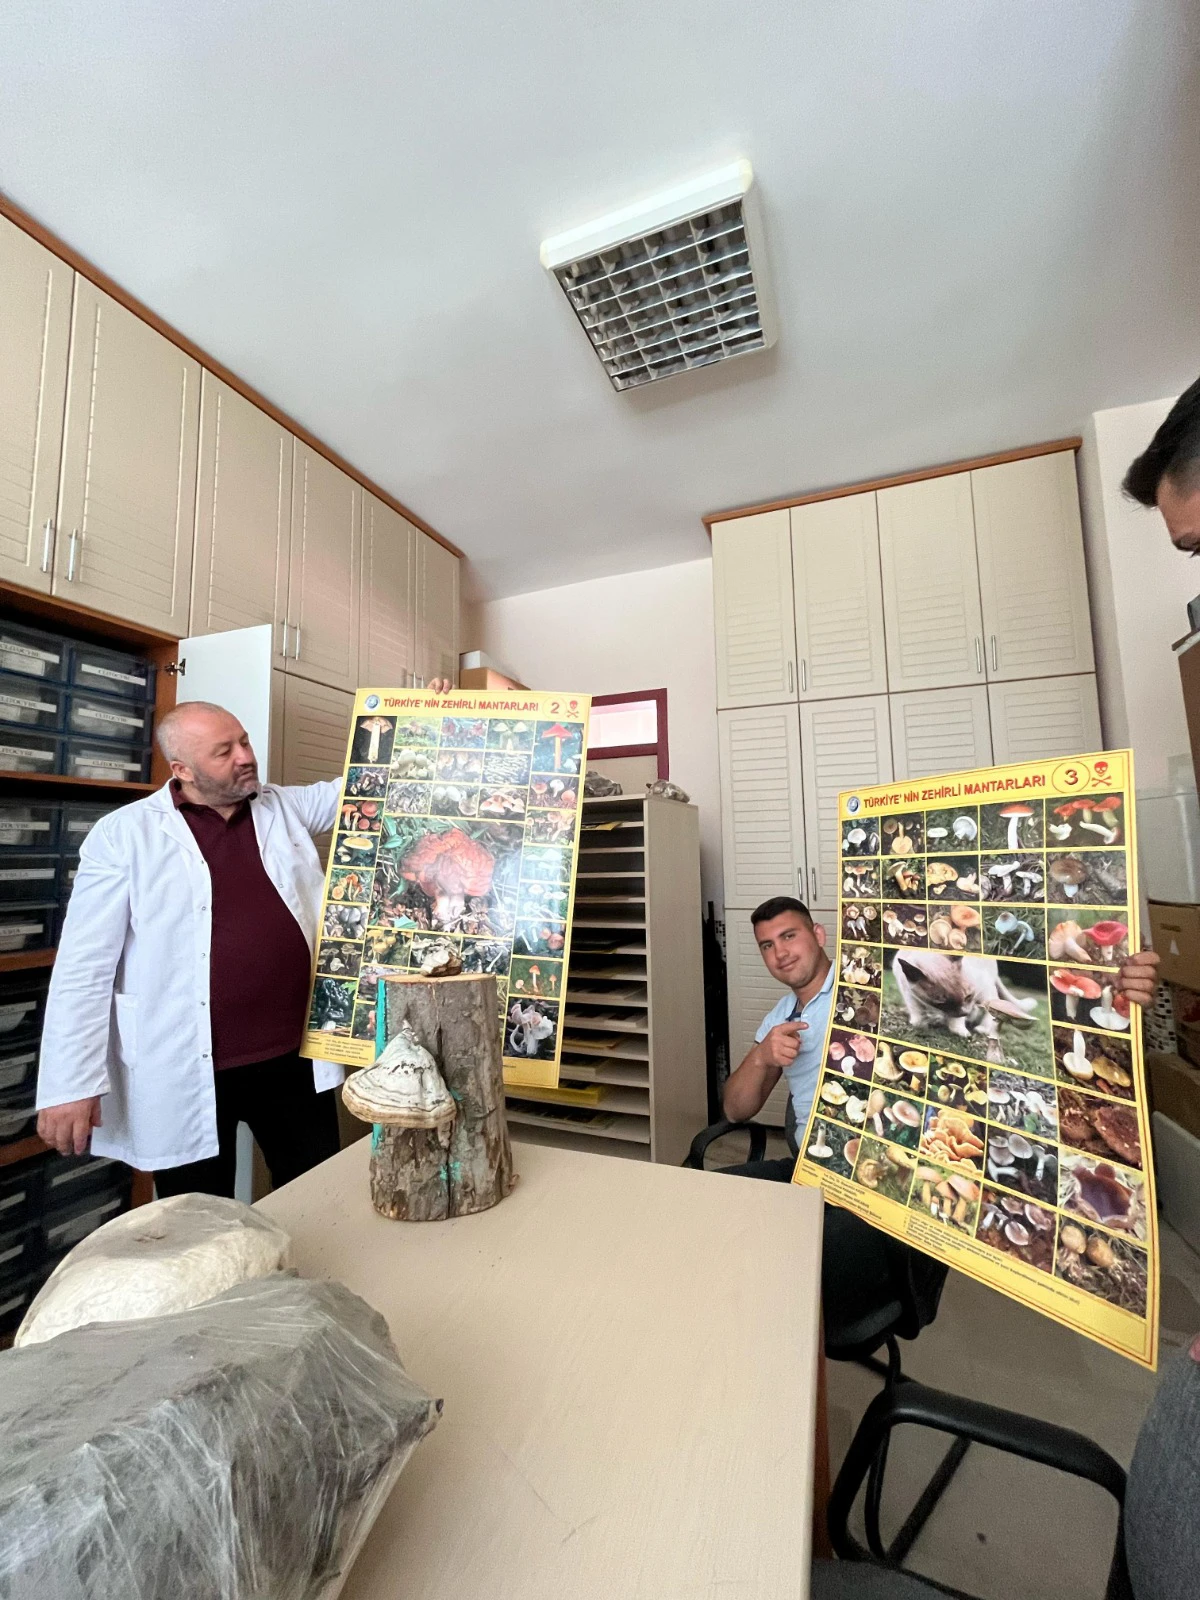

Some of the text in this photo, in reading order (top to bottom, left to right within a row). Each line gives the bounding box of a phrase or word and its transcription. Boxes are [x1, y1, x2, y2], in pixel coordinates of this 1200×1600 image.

[424, 698, 439, 709] NİN
[441, 699, 476, 710] ZEHİRLİ
[478, 701, 539, 712] MANTARLARI
[550, 702, 560, 714] 2
[903, 790, 920, 803] NİN
[921, 784, 961, 802] ZEHİRLİ
[963, 775, 1046, 796] MANTARLARI
[1064, 769, 1079, 786] 3
